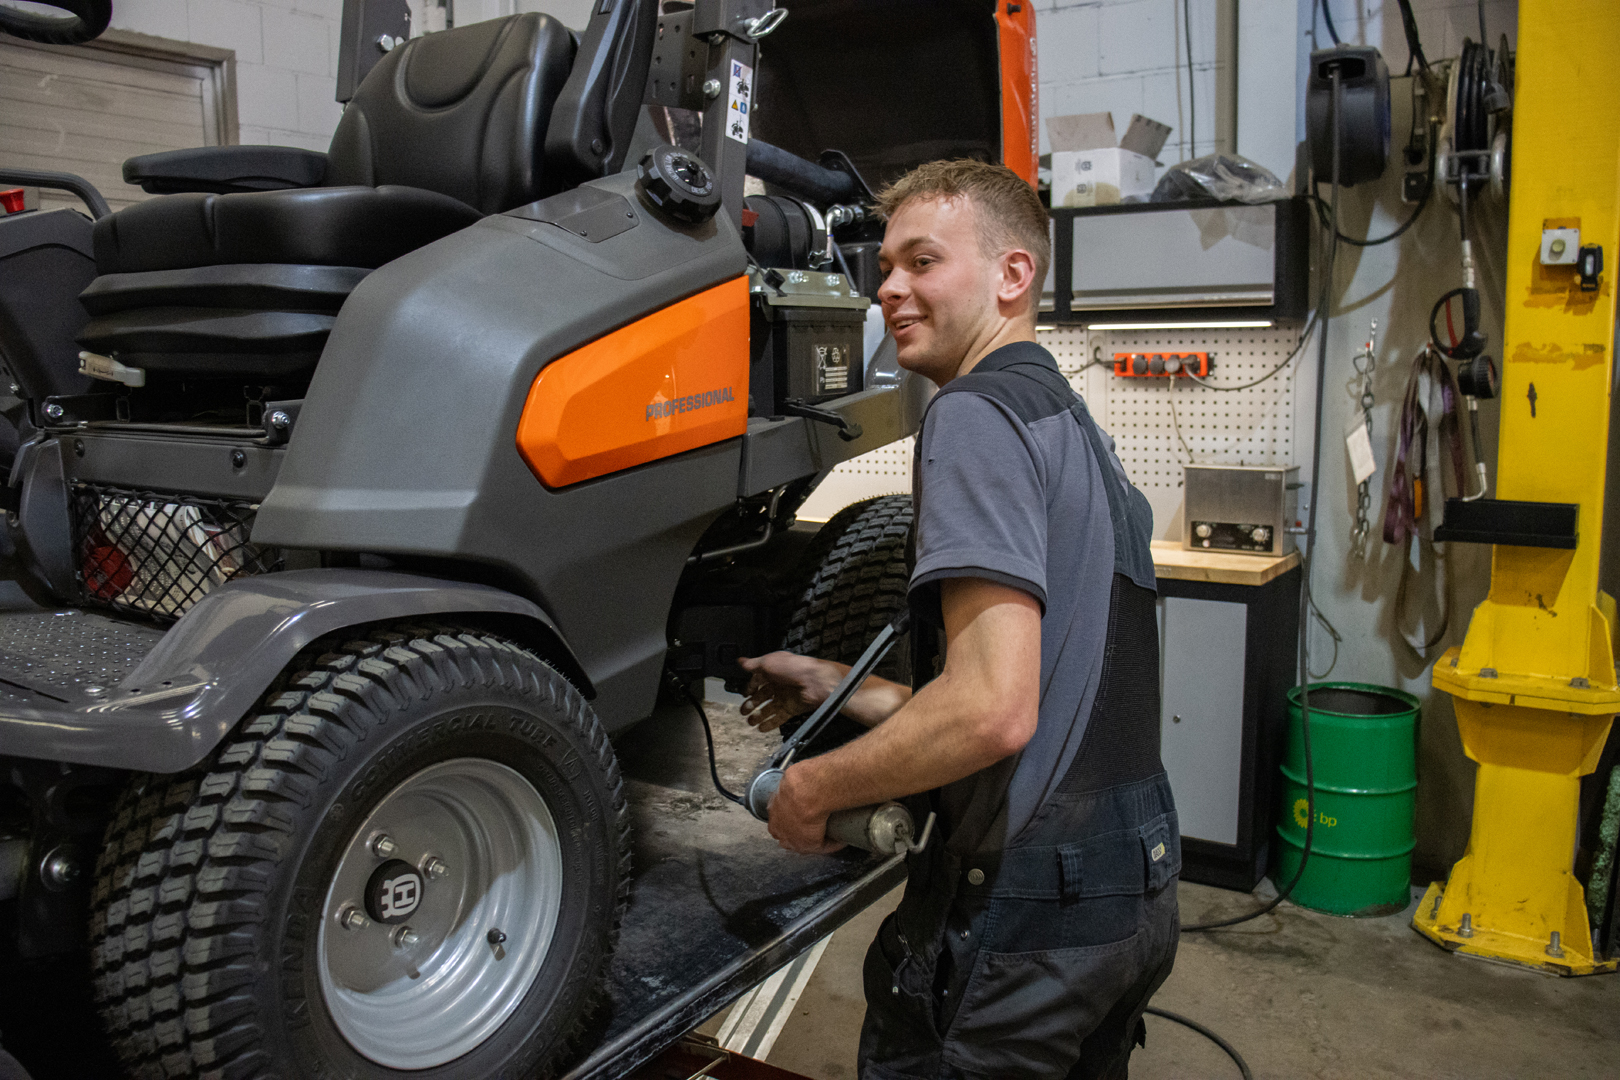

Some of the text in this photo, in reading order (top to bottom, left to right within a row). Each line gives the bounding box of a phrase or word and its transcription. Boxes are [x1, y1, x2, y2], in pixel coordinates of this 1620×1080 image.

[646, 386, 735, 422] PROFESSIONAL
[352, 714, 558, 802] COMMERCIAL TURF
[1320, 812, 1337, 828] bp
